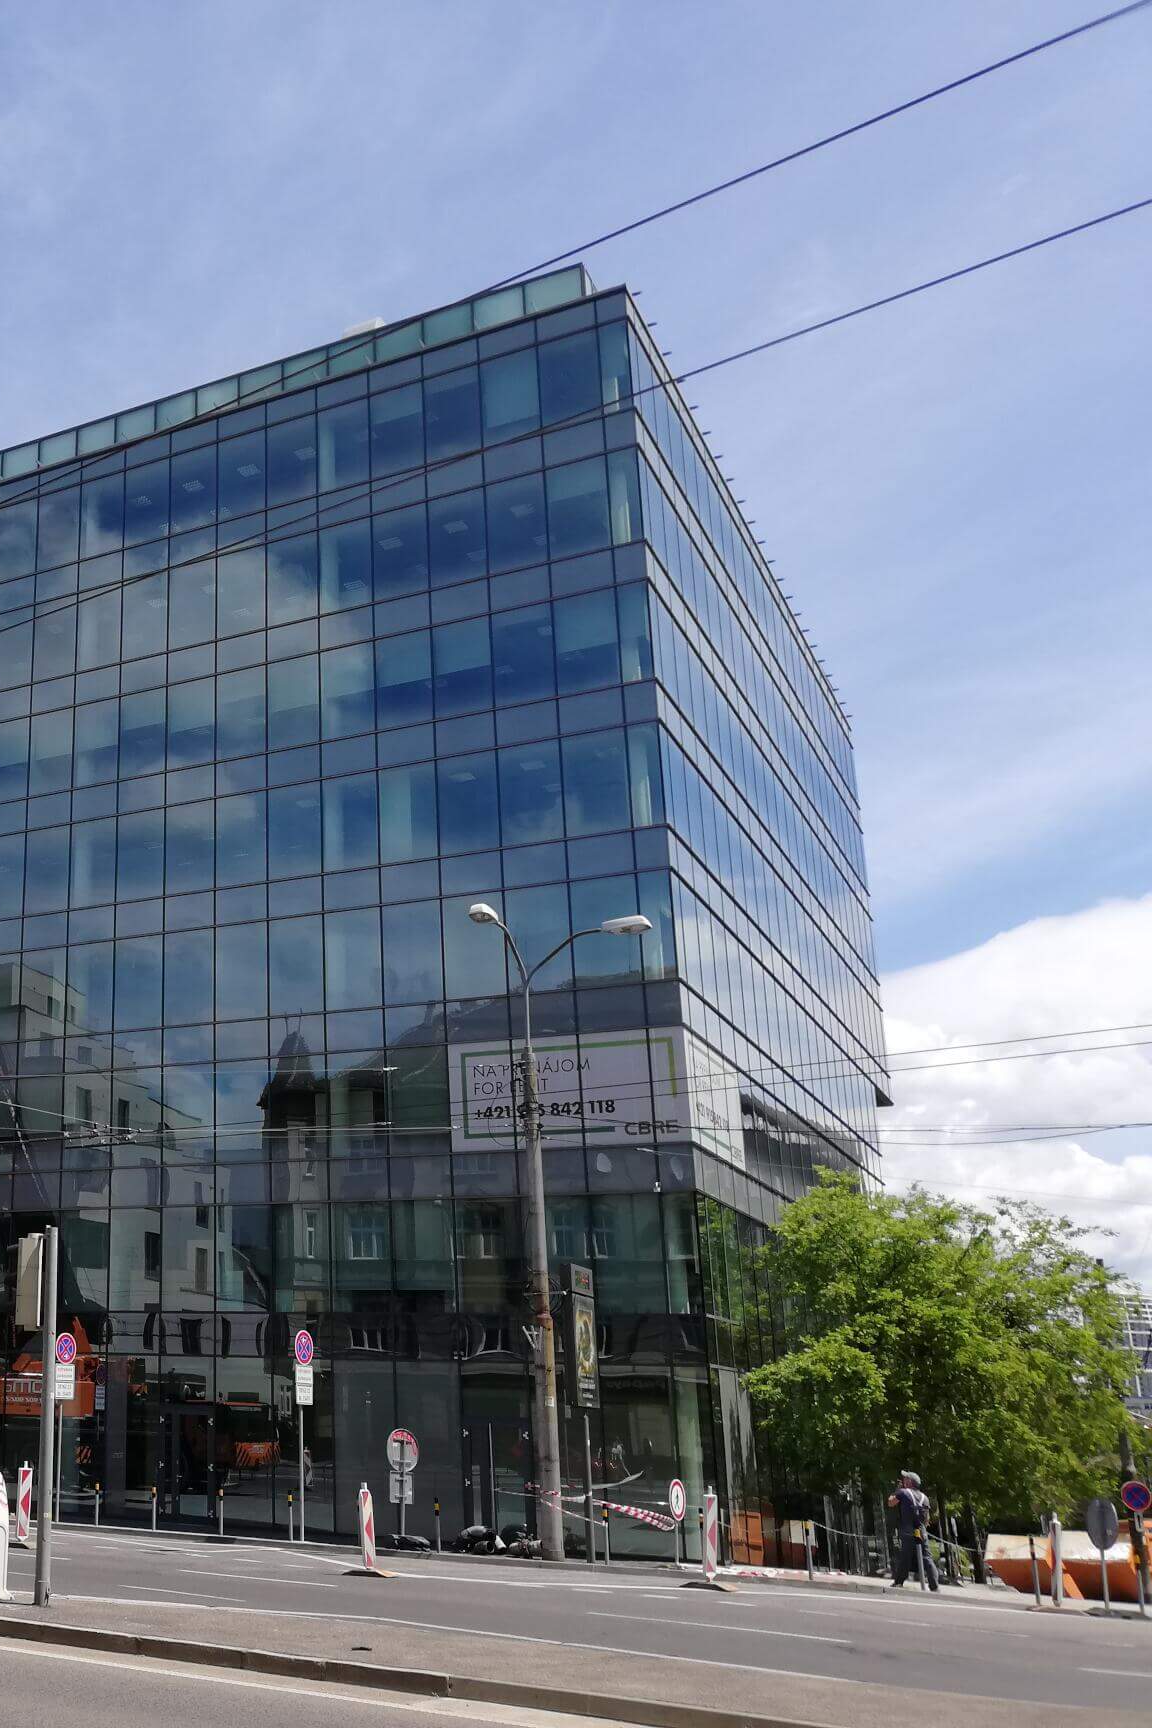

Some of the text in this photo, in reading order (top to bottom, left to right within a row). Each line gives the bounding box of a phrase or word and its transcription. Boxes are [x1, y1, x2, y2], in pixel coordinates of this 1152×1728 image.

[473, 1065, 497, 1078] NA
[474, 1081, 504, 1095] FOR
[474, 1105, 511, 1118] +421
[550, 1101, 583, 1117] 842
[588, 1099, 616, 1114] 118
[624, 1119, 679, 1136] CBRE
